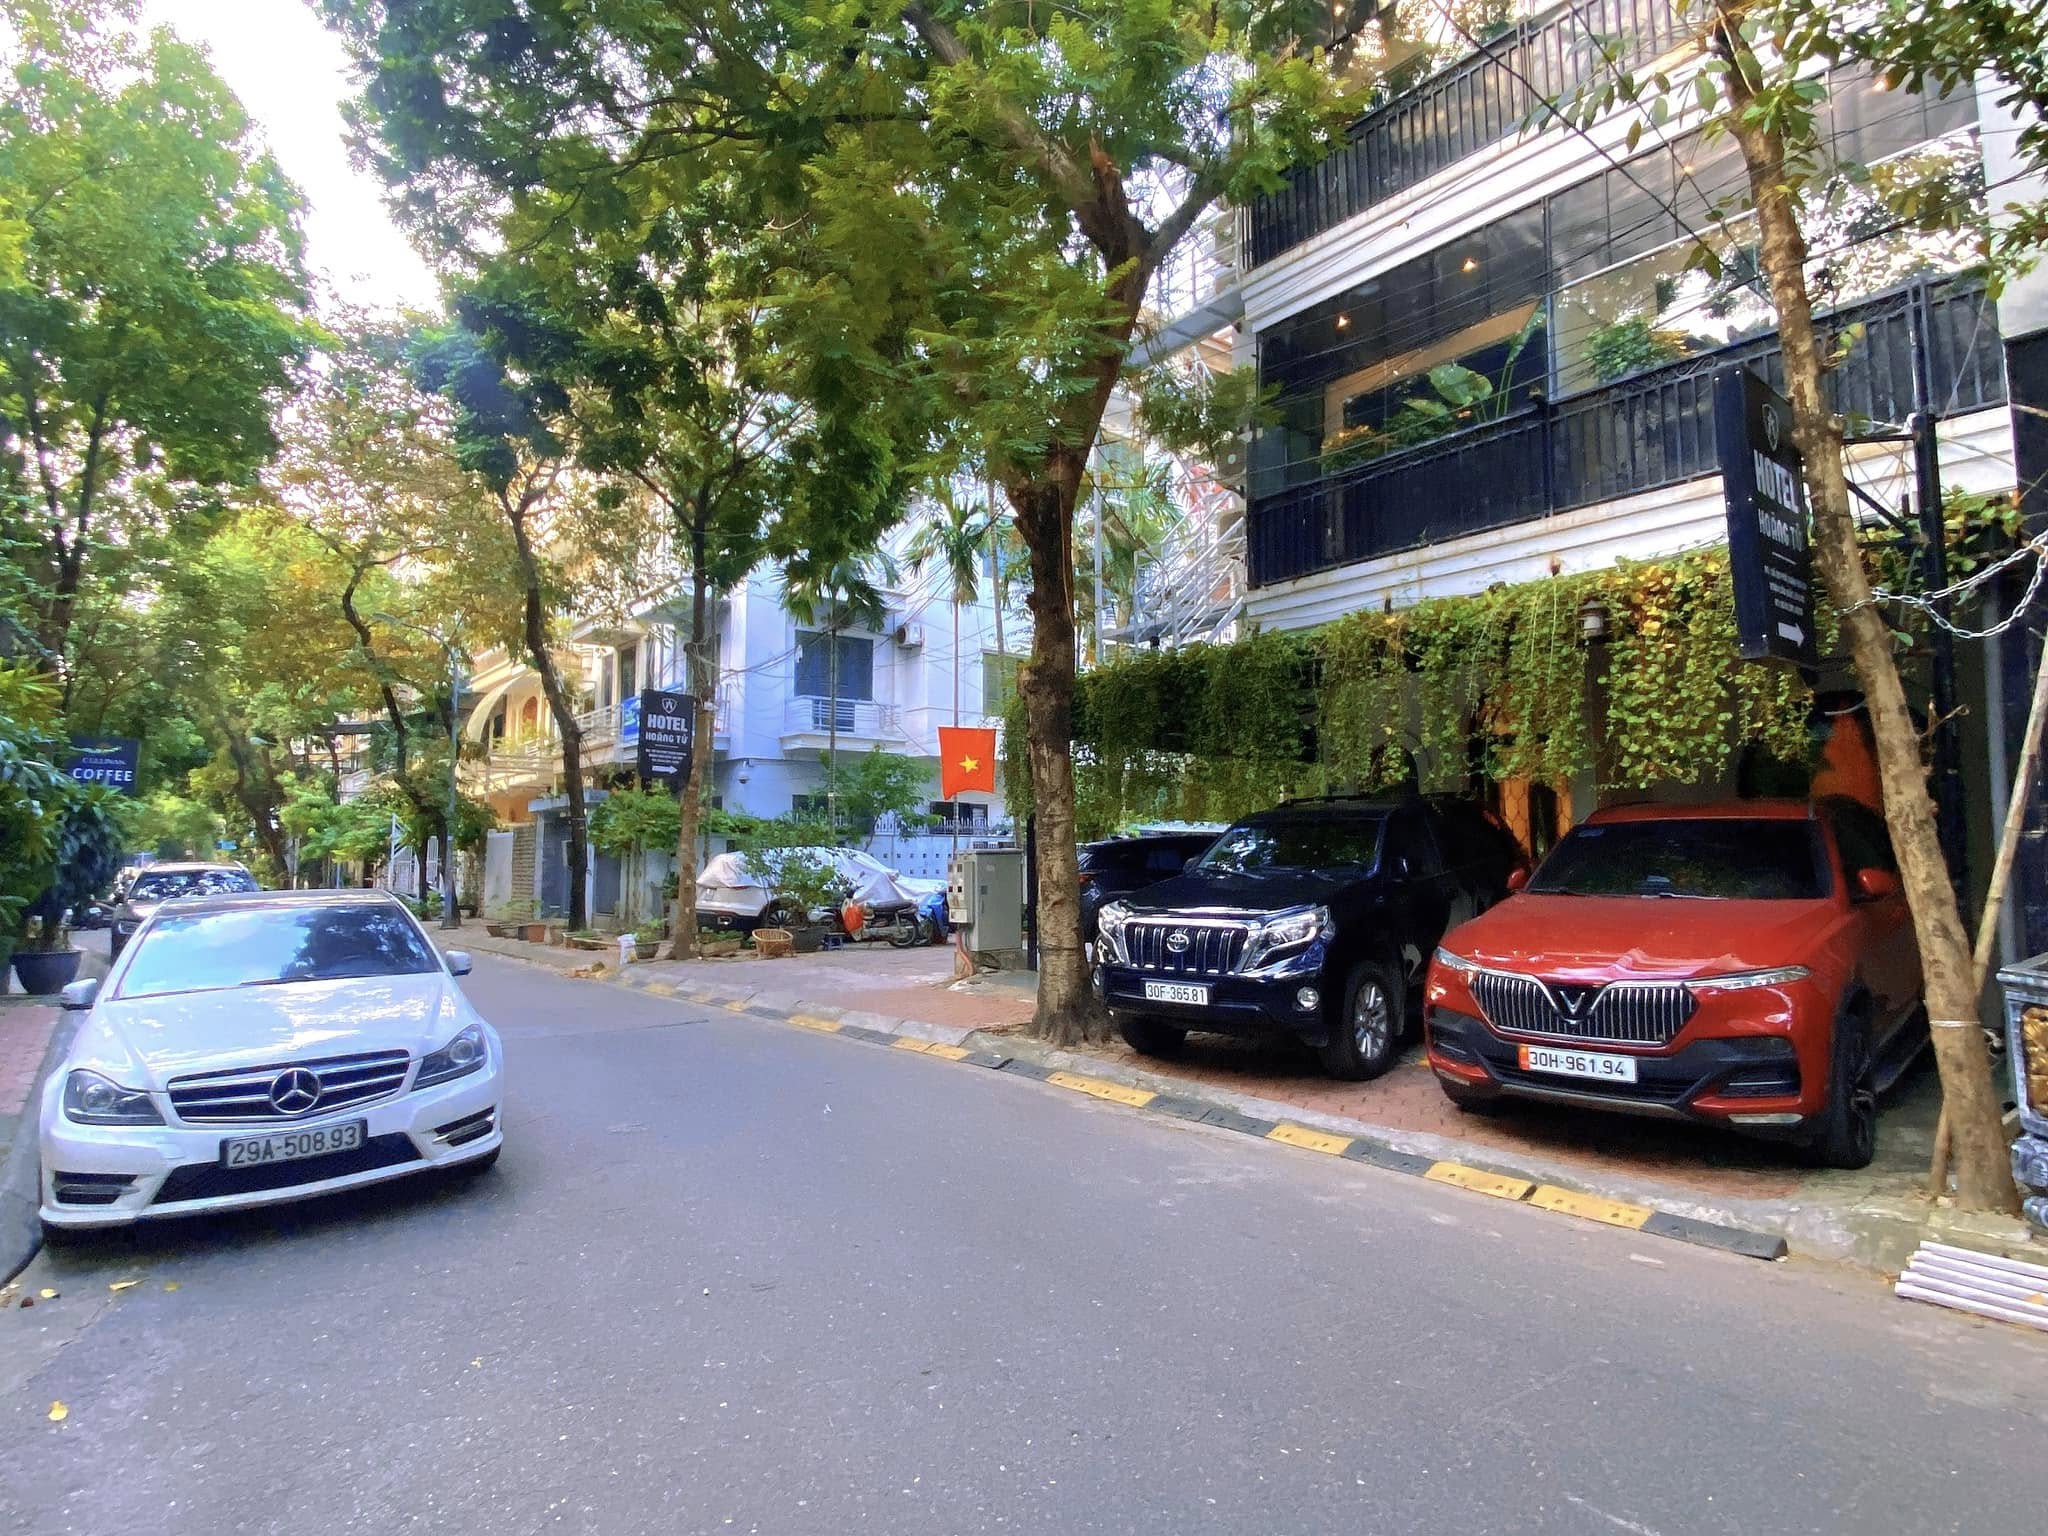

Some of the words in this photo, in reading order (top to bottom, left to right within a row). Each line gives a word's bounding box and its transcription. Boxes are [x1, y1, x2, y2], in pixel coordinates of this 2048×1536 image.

[1753, 448, 1800, 514] HOTEL
[647, 713, 689, 733] HOTEL
[72, 767, 133, 782] COFFEE
[1146, 984, 1205, 1004] 30F-365.81
[1529, 1050, 1625, 1077] 30H-961.94
[231, 1125, 358, 1165] 29A-508.93
